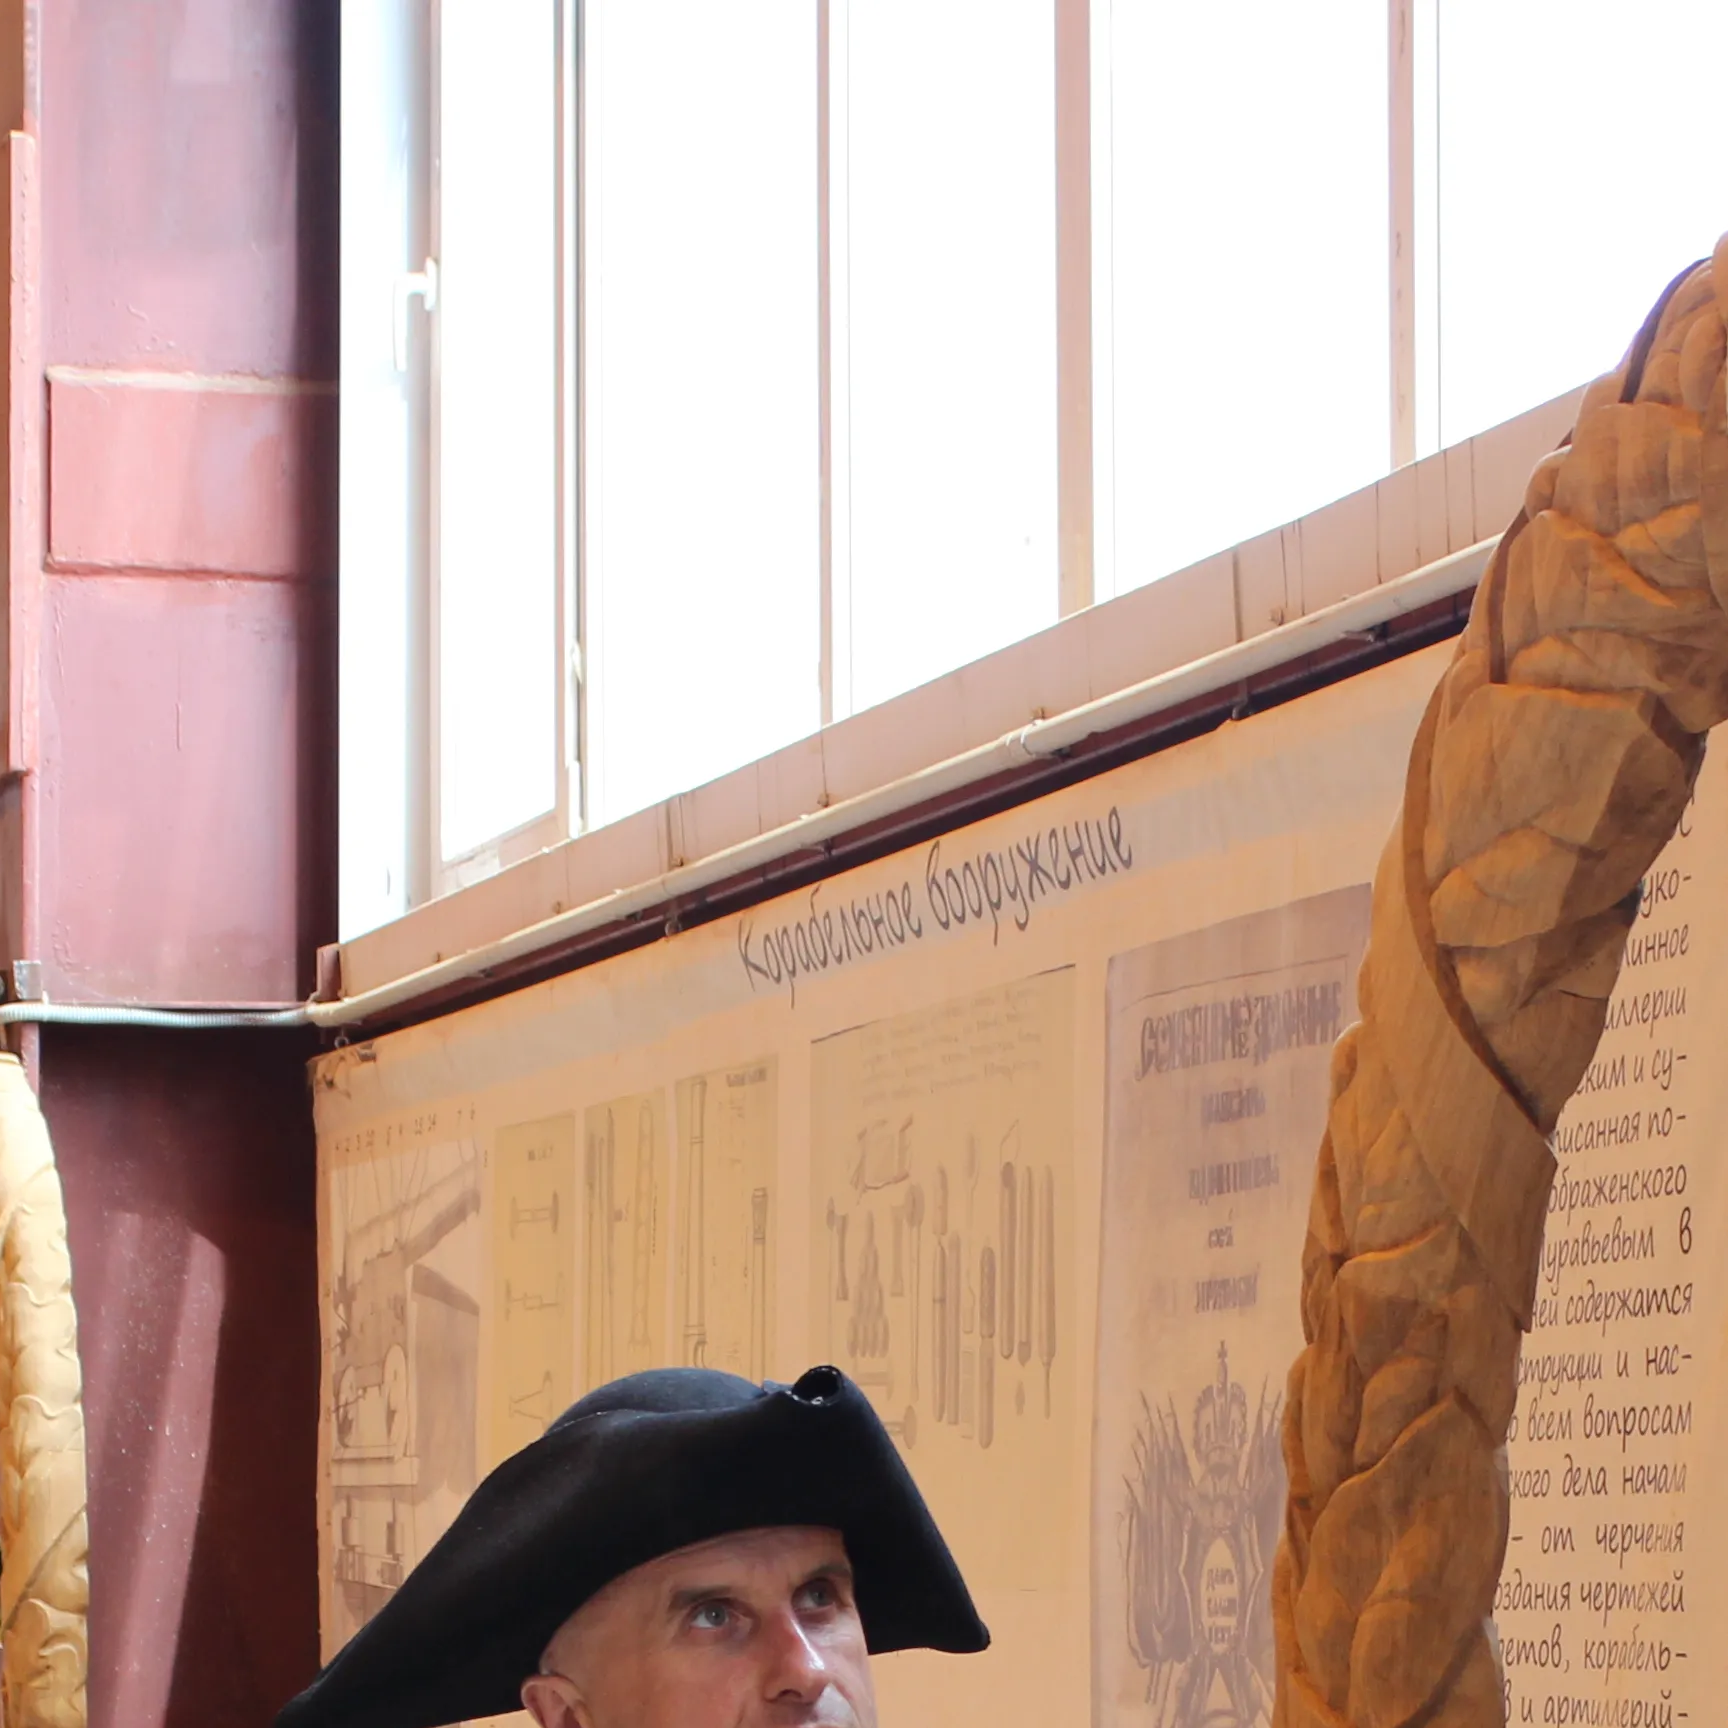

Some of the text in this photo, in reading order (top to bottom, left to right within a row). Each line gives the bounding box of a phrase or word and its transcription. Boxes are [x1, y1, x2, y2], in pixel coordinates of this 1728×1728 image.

[738, 806, 1133, 1009] Корабельное вооружение
[1634, 1055, 1643, 1082] и
[1651, 1047, 1687, 1091] су-
[1647, 1105, 1686, 1139] по-
[1679, 1205, 1692, 1255] в
[1565, 1280, 1693, 1337] содержатся
[1616, 1350, 1630, 1378] и
[1645, 1344, 1693, 1377] нас-
[1528, 1396, 1573, 1443] всем
[1583, 1393, 1693, 1453] вопросам
[1562, 1453, 1608, 1498] дела
[1622, 1462, 1687, 1497] начала
[1541, 1525, 1576, 1554] от
[1595, 1521, 1685, 1570] черчения
[1580, 1569, 1686, 1628] чертежей
[1584, 1623, 1688, 1687] корабель-
[1521, 1696, 1534, 1722] и
